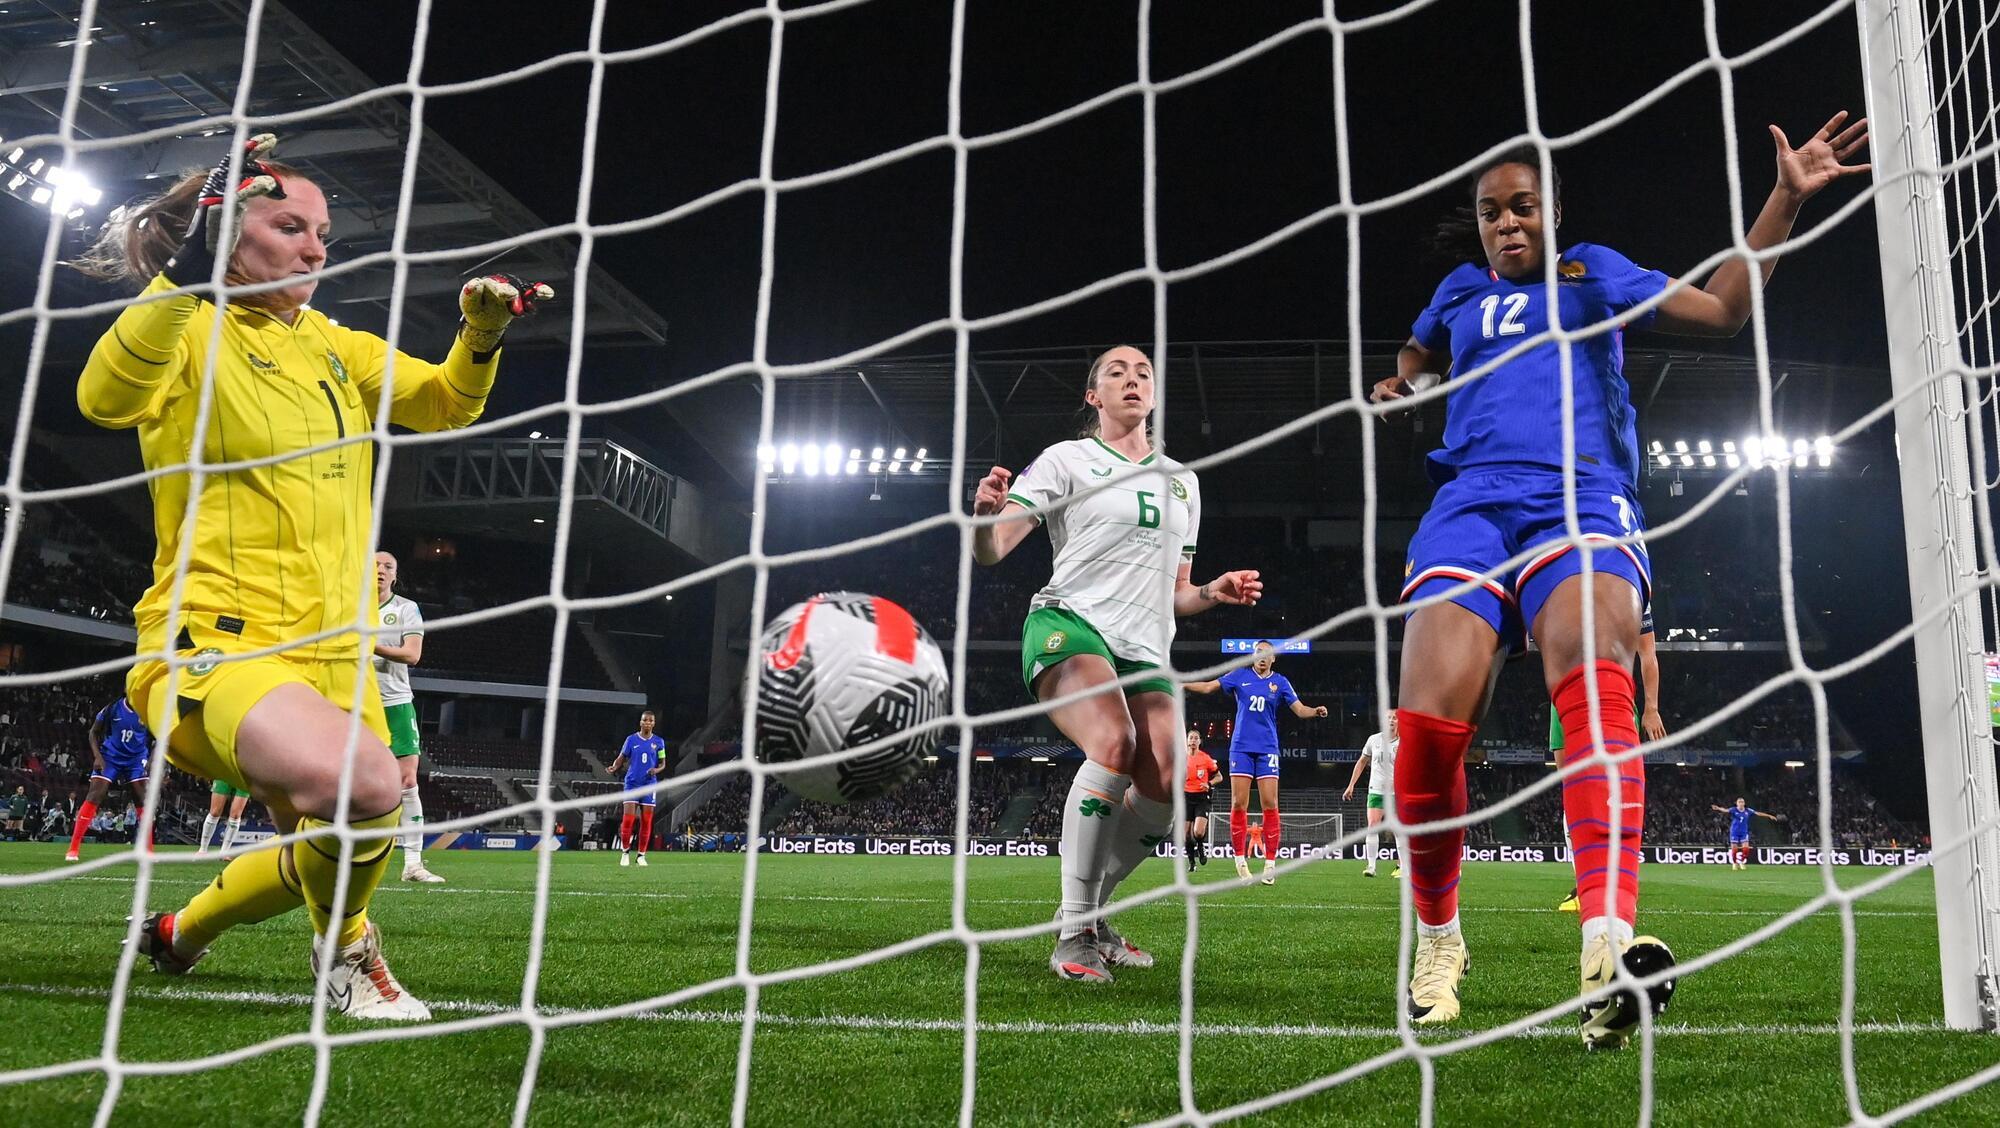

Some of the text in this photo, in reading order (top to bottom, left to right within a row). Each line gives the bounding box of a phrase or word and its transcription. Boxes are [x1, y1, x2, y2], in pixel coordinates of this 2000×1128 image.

[1480, 292, 1530, 339] 12
[317, 380, 345, 439] 1
[1136, 490, 1161, 529] 6
[1248, 695, 1266, 712] 20
[120, 729, 134, 743] 19
[641, 752, 648, 764] 8
[770, 837, 855, 854] Uber Eats
[865, 839, 951, 855] Uber Eats
[1006, 840, 1048, 857] Eats
[1500, 846, 1544, 862] Eats
[1655, 848, 1699, 864] Uber
[1702, 848, 1748, 864] Eats
[1757, 849, 1801, 865] Uber
[1860, 849, 1901, 866] Uber
